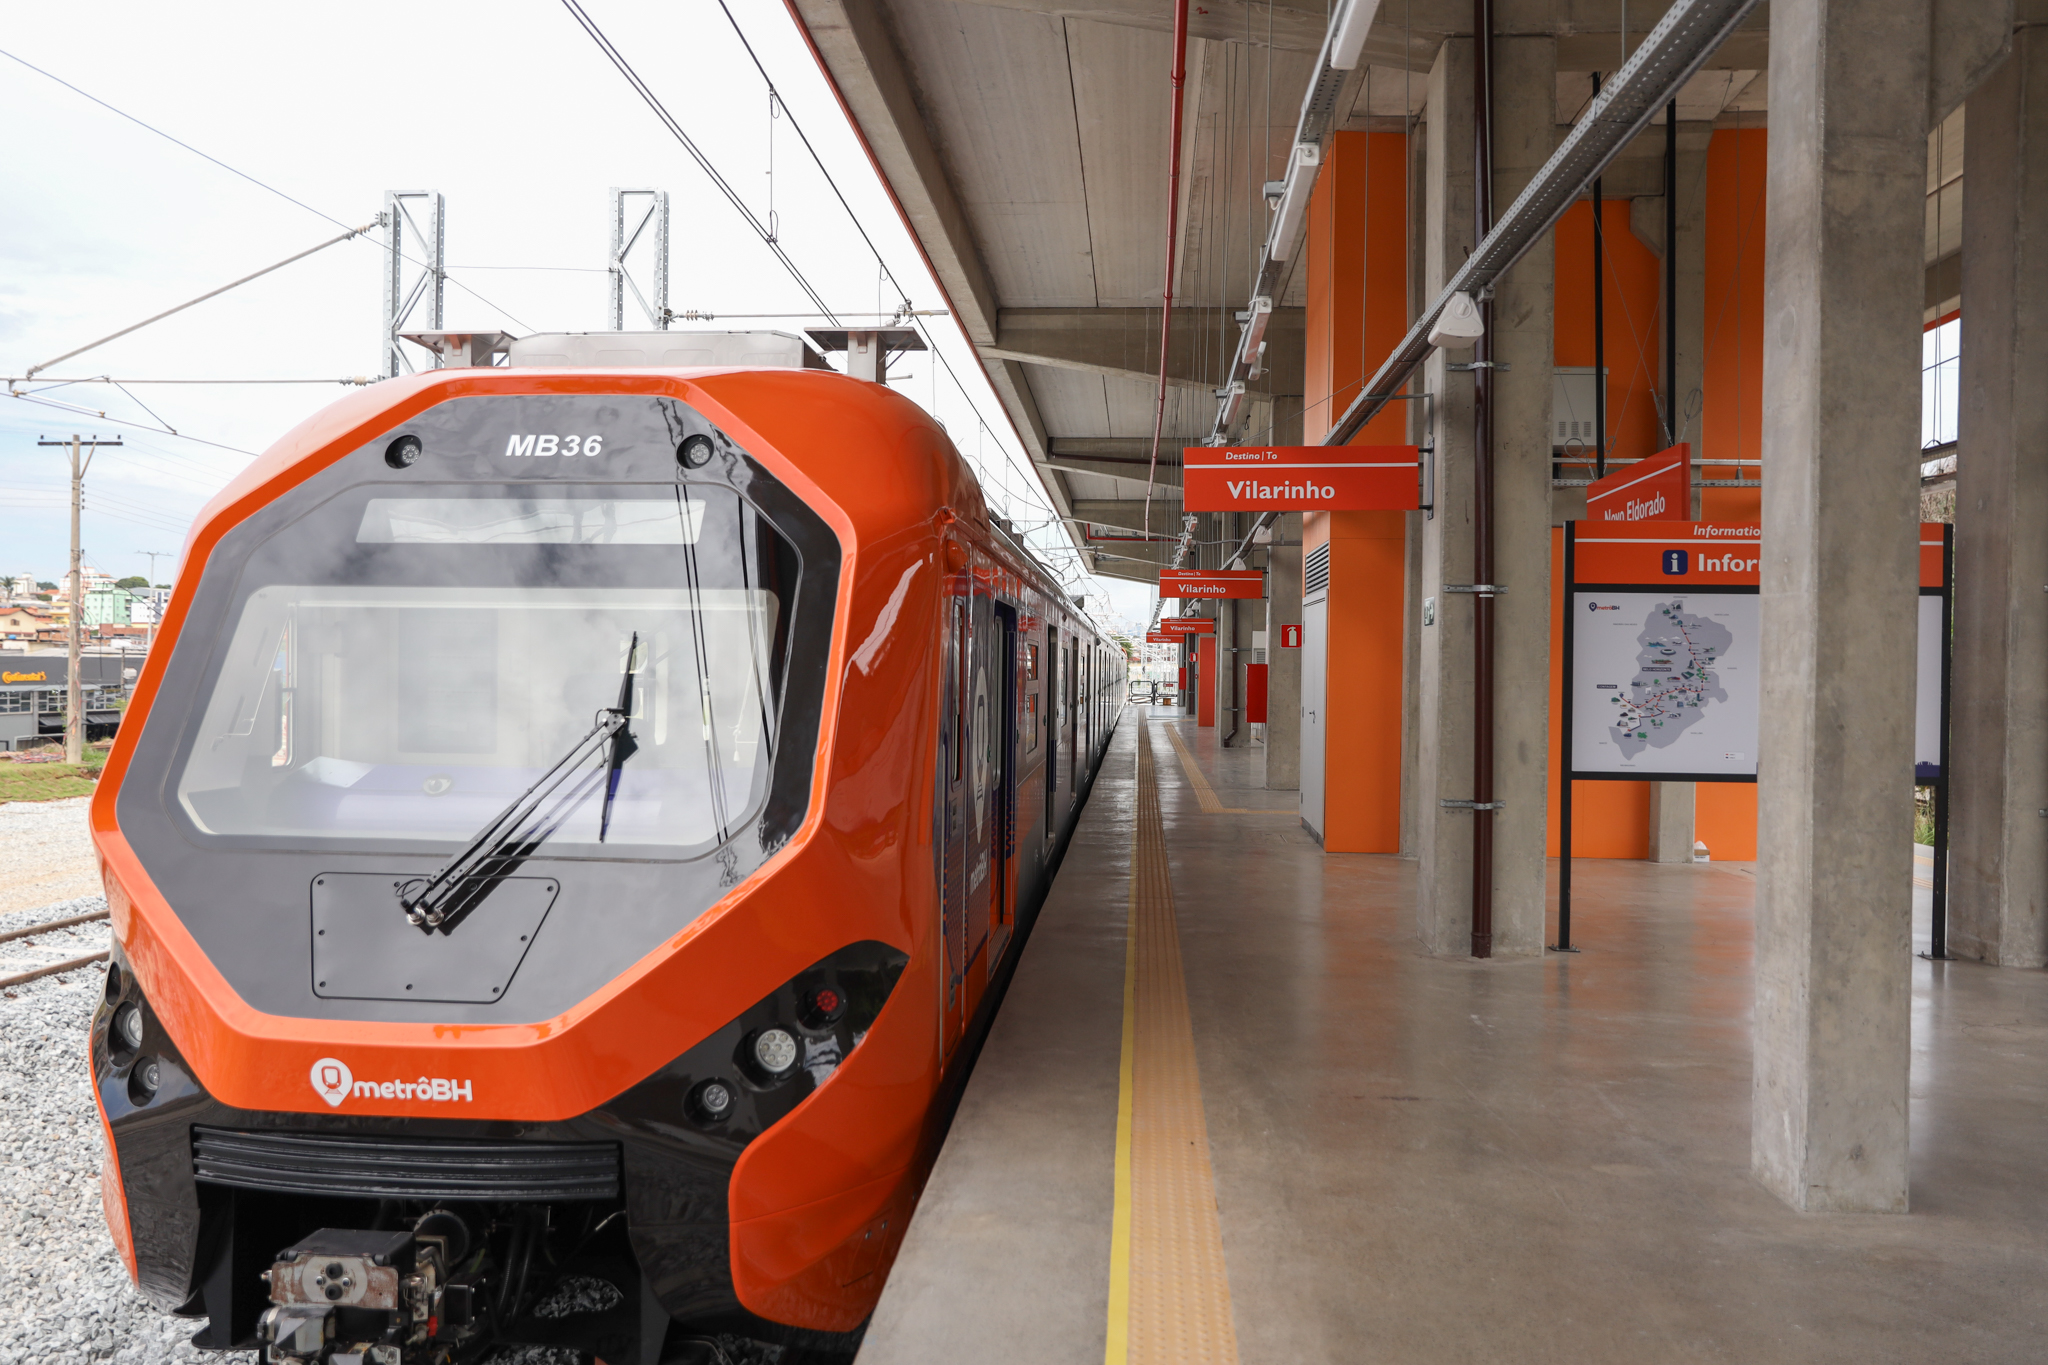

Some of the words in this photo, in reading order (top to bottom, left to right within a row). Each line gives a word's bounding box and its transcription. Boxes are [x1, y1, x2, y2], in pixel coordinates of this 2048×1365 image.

[505, 434, 603, 457] MB36
[1225, 451, 1260, 460] Destino
[1266, 451, 1278, 460] To
[1226, 480, 1336, 500] Vilarinho
[1626, 491, 1666, 521] Eldorado
[1698, 553, 1761, 572] Infor
[1178, 584, 1226, 594] Vilarinho
[353, 1076, 473, 1102] metrôBH
